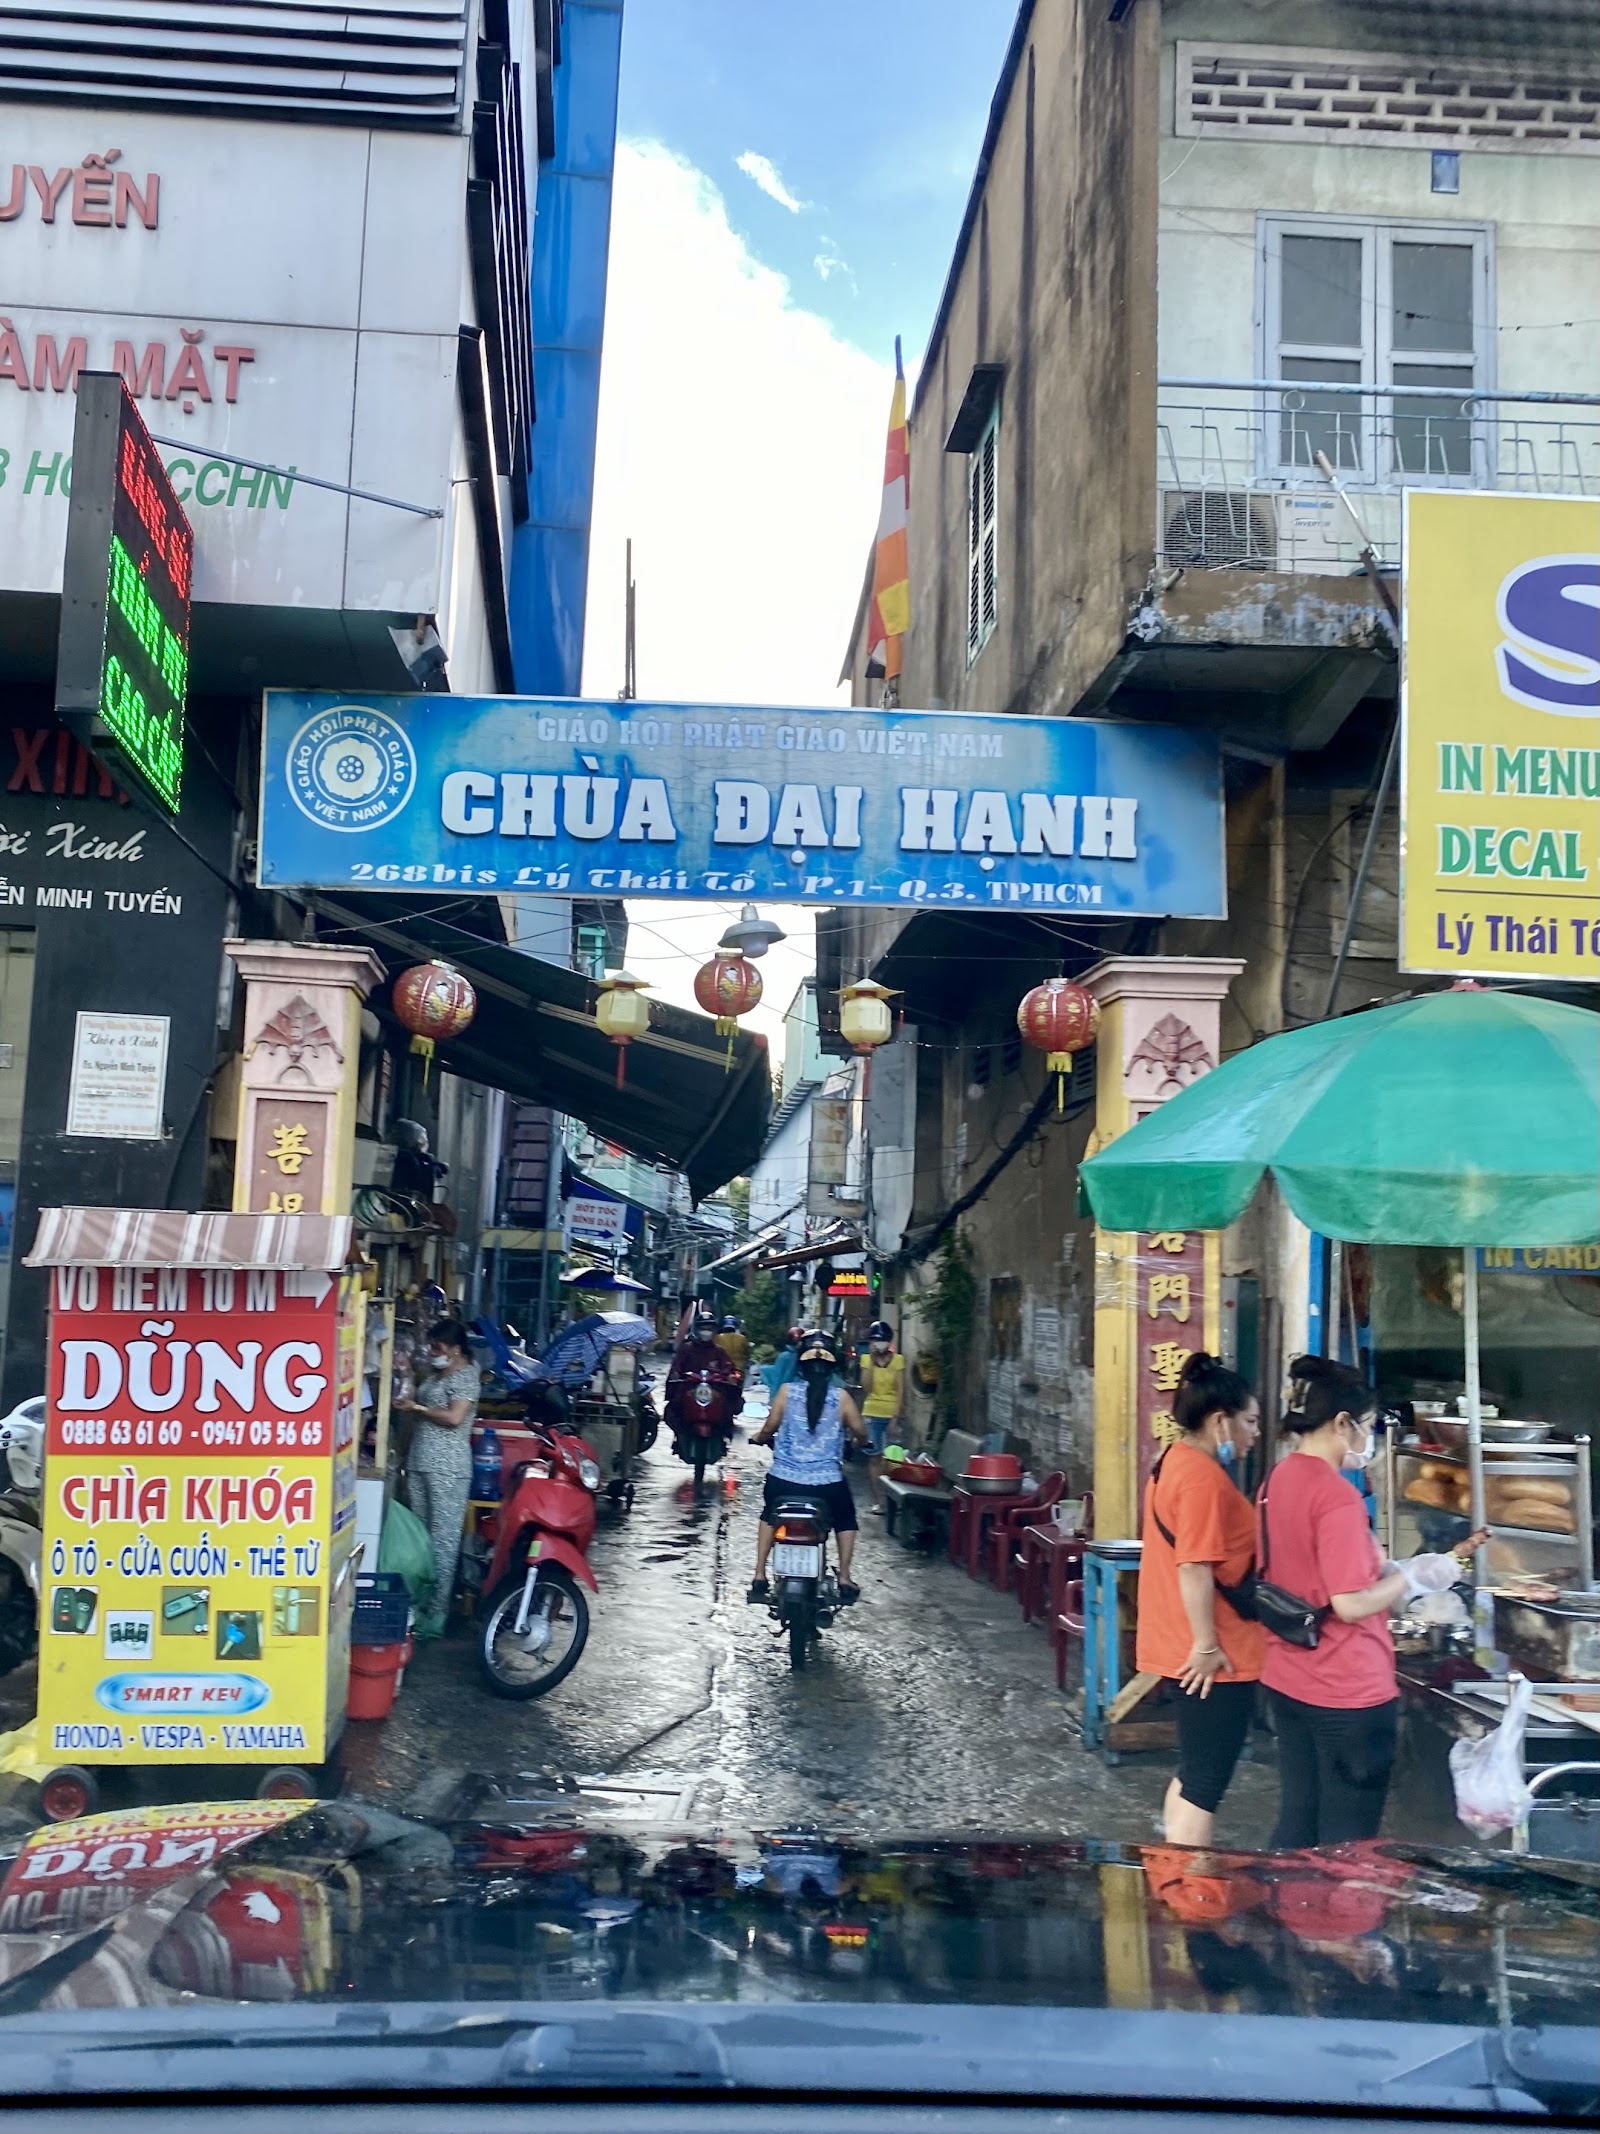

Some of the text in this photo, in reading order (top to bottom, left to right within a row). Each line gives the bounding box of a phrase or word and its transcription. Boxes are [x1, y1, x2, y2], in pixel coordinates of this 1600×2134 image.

[113, 329, 255, 413] MẶT
[105, 655, 145, 750] CAO
[294, 716, 409, 787] GIÁO HỘI PHẬT GIÁO
[538, 712, 609, 743] GIÁO
[620, 715, 672, 751] HỘI
[683, 716, 766, 752] PHẬT
[857, 724, 928, 759] VIỆT
[939, 733, 1004, 757] NAM
[1437, 742, 1600, 798] IN MENU
[313, 799, 388, 821] VIỆT NAM
[441, 756, 1138, 871] CHÙA ĐẠI HẠNH
[46, 822, 147, 862] Xinh
[1437, 824, 1588, 880] DECAL
[36, 887, 93, 909] MINH
[104, 887, 182, 915] TUYẾN
[350, 863, 498, 884] 268bis
[512, 863, 570, 890] Lý
[588, 869, 690, 890] Thái
[985, 880, 1104, 905] TPHCM
[1437, 912, 1474, 955] Lý
[1486, 914, 1558, 955] Thái
[201, 1269, 235, 1312] 10
[245, 1270, 276, 1312] M
[56, 1319, 328, 1413] DŨNG
[61, 1419, 106, 1445] 0888
[110, 1420, 132, 1445] 63
[135, 1420, 154, 1445] 61
[158, 1420, 183, 1445] 60
[201, 1420, 247, 1445] 0947
[249, 1421, 272, 1446] 05
[275, 1421, 298, 1446] 56
[301, 1421, 322, 1446] 65
[62, 1467, 168, 1525] CHÌA
[183, 1467, 314, 1526] KHÓA
[51, 1539, 66, 1576] Ô
[72, 1539, 98, 1576] TÔ
[120, 1535, 162, 1576] CỬA
[170, 1531, 227, 1577] CUỐN
[248, 1535, 286, 1576] THẺ
[294, 1539, 321, 1576] TỪ
[123, 1687, 242, 1701] SMART KEY
[54, 1725, 123, 1748] HONDA
[141, 1726, 203, 1748] VESPA
[223, 1726, 305, 1748] YAMAHA
